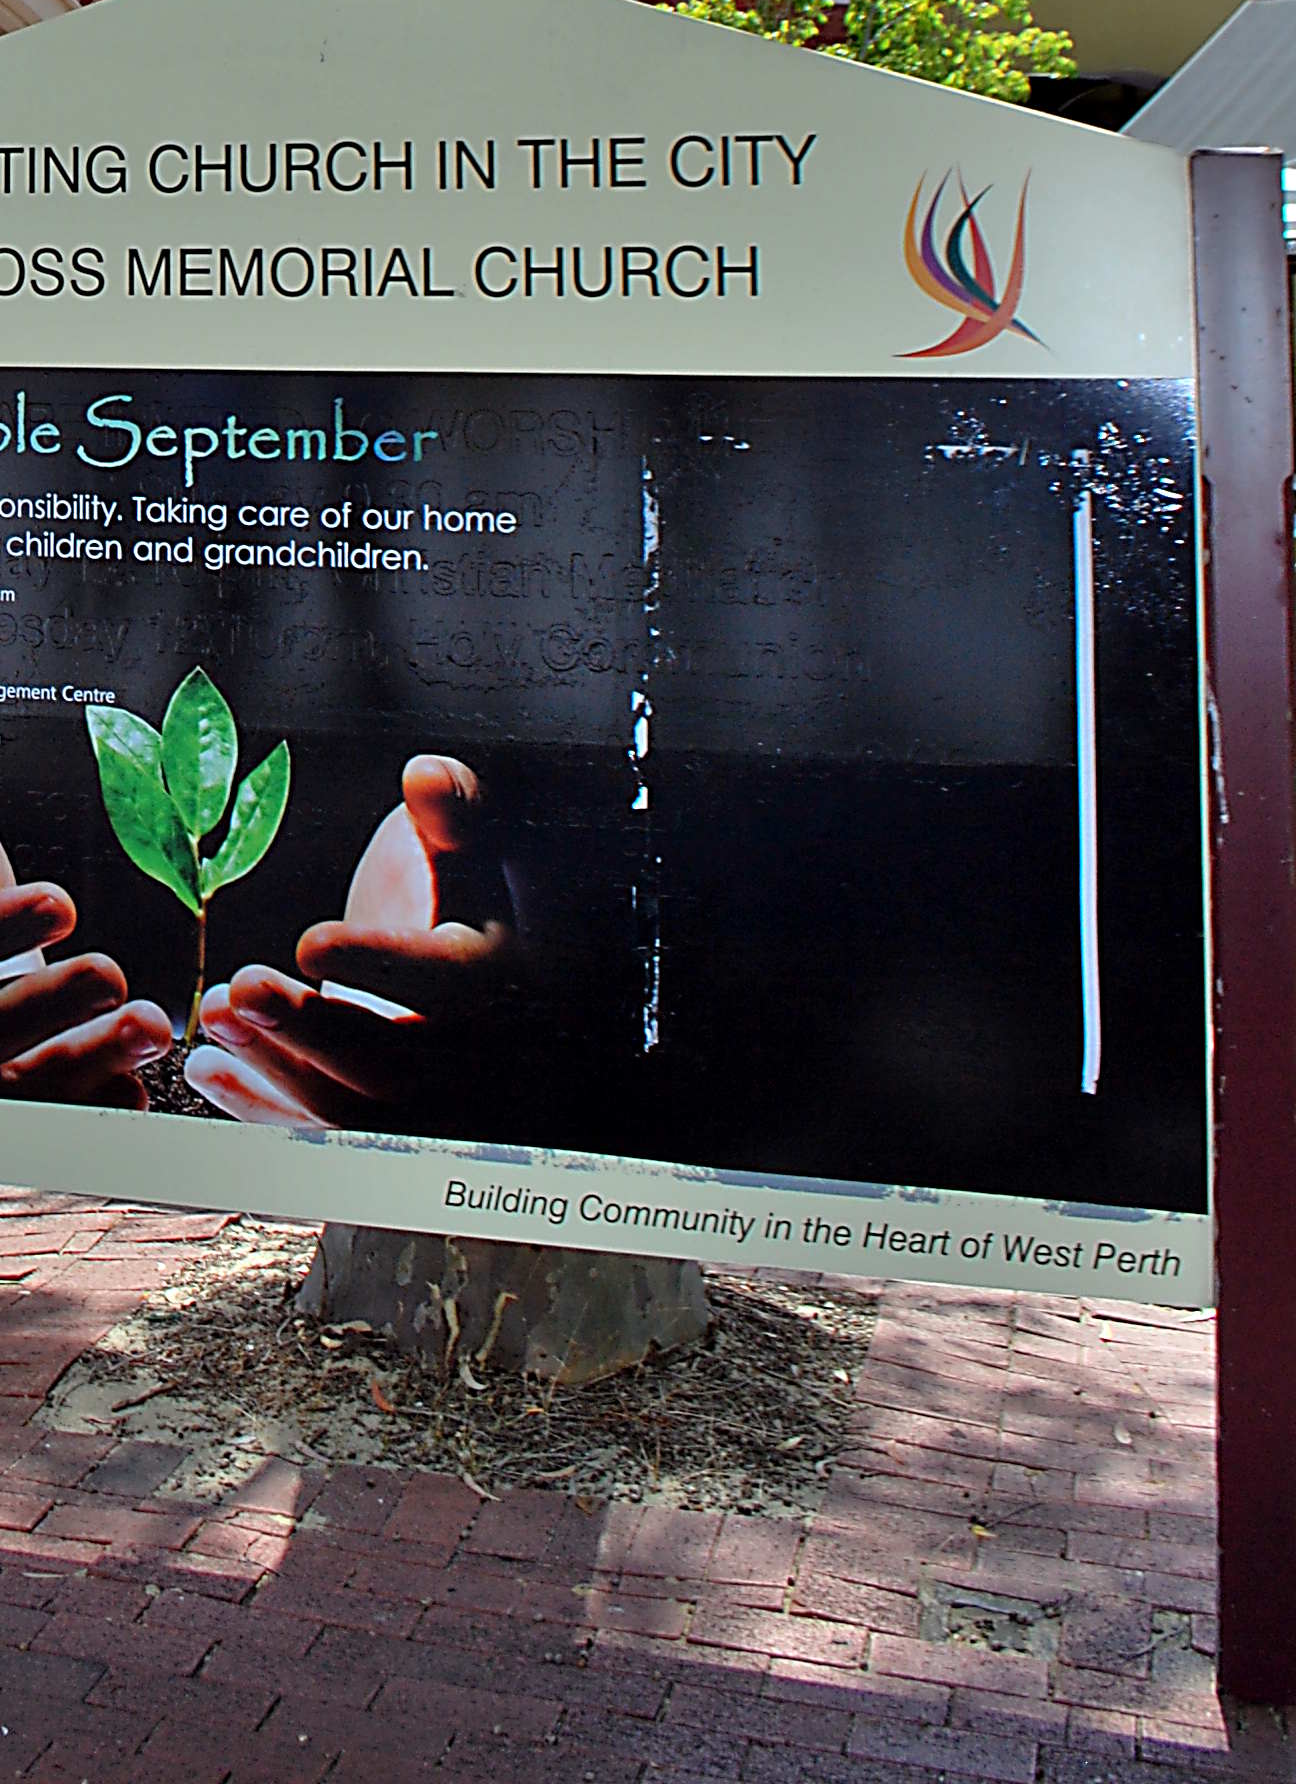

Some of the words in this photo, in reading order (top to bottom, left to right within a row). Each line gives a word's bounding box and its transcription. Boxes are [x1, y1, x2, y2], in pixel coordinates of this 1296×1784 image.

[150, 142, 412, 193] CHURCH
[439, 140, 494, 189] IN
[518, 138, 646, 188] THE
[671, 135, 816, 187] CITY
[129, 247, 454, 297] MEMORIAL
[476, 246, 757, 297] CHURCH
[77, 395, 438, 487] September
[132, 497, 226, 531] Taking
[239, 506, 309, 527] care
[321, 502, 351, 528] of
[363, 509, 414, 529] our
[424, 505, 516, 533] home
[7, 531, 122, 559] children
[134, 537, 192, 562] and
[205, 540, 428, 570] grandchildren.
[62, 686, 115, 708] Centre
[445, 1181, 567, 1224] Building
[580, 1195, 755, 1243] Community
[765, 1213, 791, 1240] in
[804, 1218, 851, 1246] the
[863, 1222, 950, 1255] Heart
[961, 1233, 993, 1258] of
[1005, 1235, 1083, 1268] West
[1094, 1243, 1180, 1276] Perth
